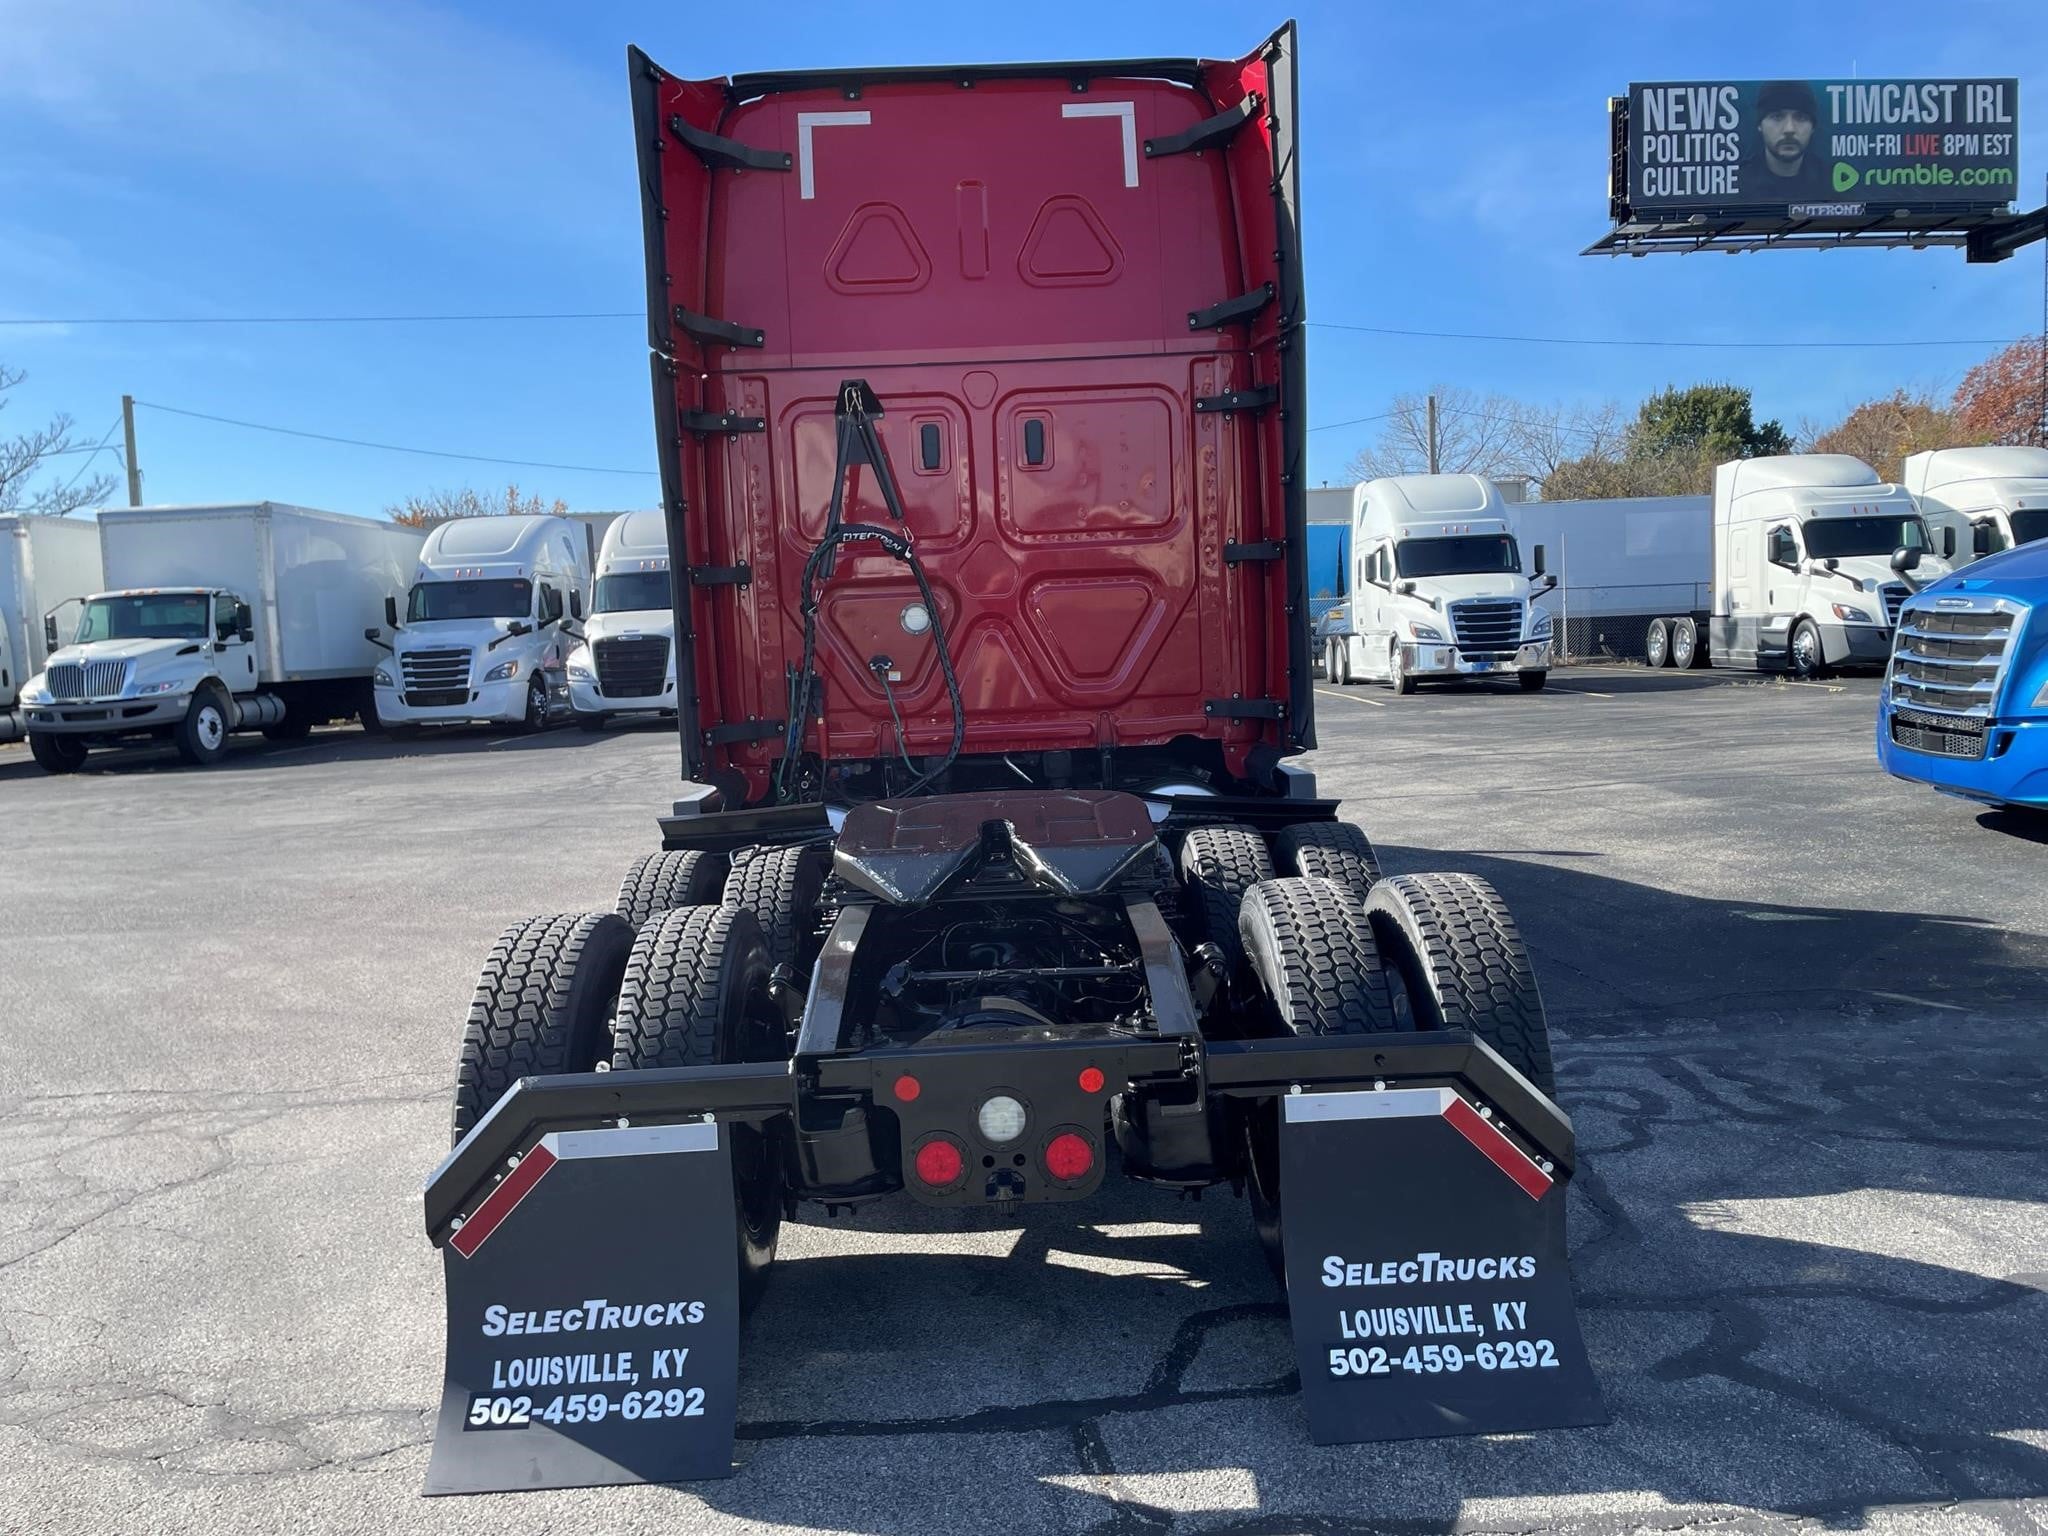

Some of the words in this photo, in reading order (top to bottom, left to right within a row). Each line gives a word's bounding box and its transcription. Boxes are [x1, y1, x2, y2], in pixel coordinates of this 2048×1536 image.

[1643, 86, 1739, 132] NEWS
[1826, 84, 1958, 125] TIMCAST
[1966, 84, 2012, 124] IRL
[1642, 133, 1740, 164] POLITICS
[1832, 134, 1901, 157] MON-FRI
[1904, 134, 1940, 156] LIVE
[1943, 134, 1979, 156] 8PM
[1983, 133, 2013, 156] EST
[1642, 165, 1740, 197] CULTURE
[1864, 162, 2014, 187] rumble.com
[1339, 1304, 1484, 1338] LOUISVILLE,
[1492, 1301, 1527, 1331] KY
[492, 1352, 640, 1389] LOUISVILLE,
[651, 1348, 689, 1379] KY
[1328, 1339, 1560, 1376] 502-459-6292
[469, 1387, 706, 1426] 502-459-6292
